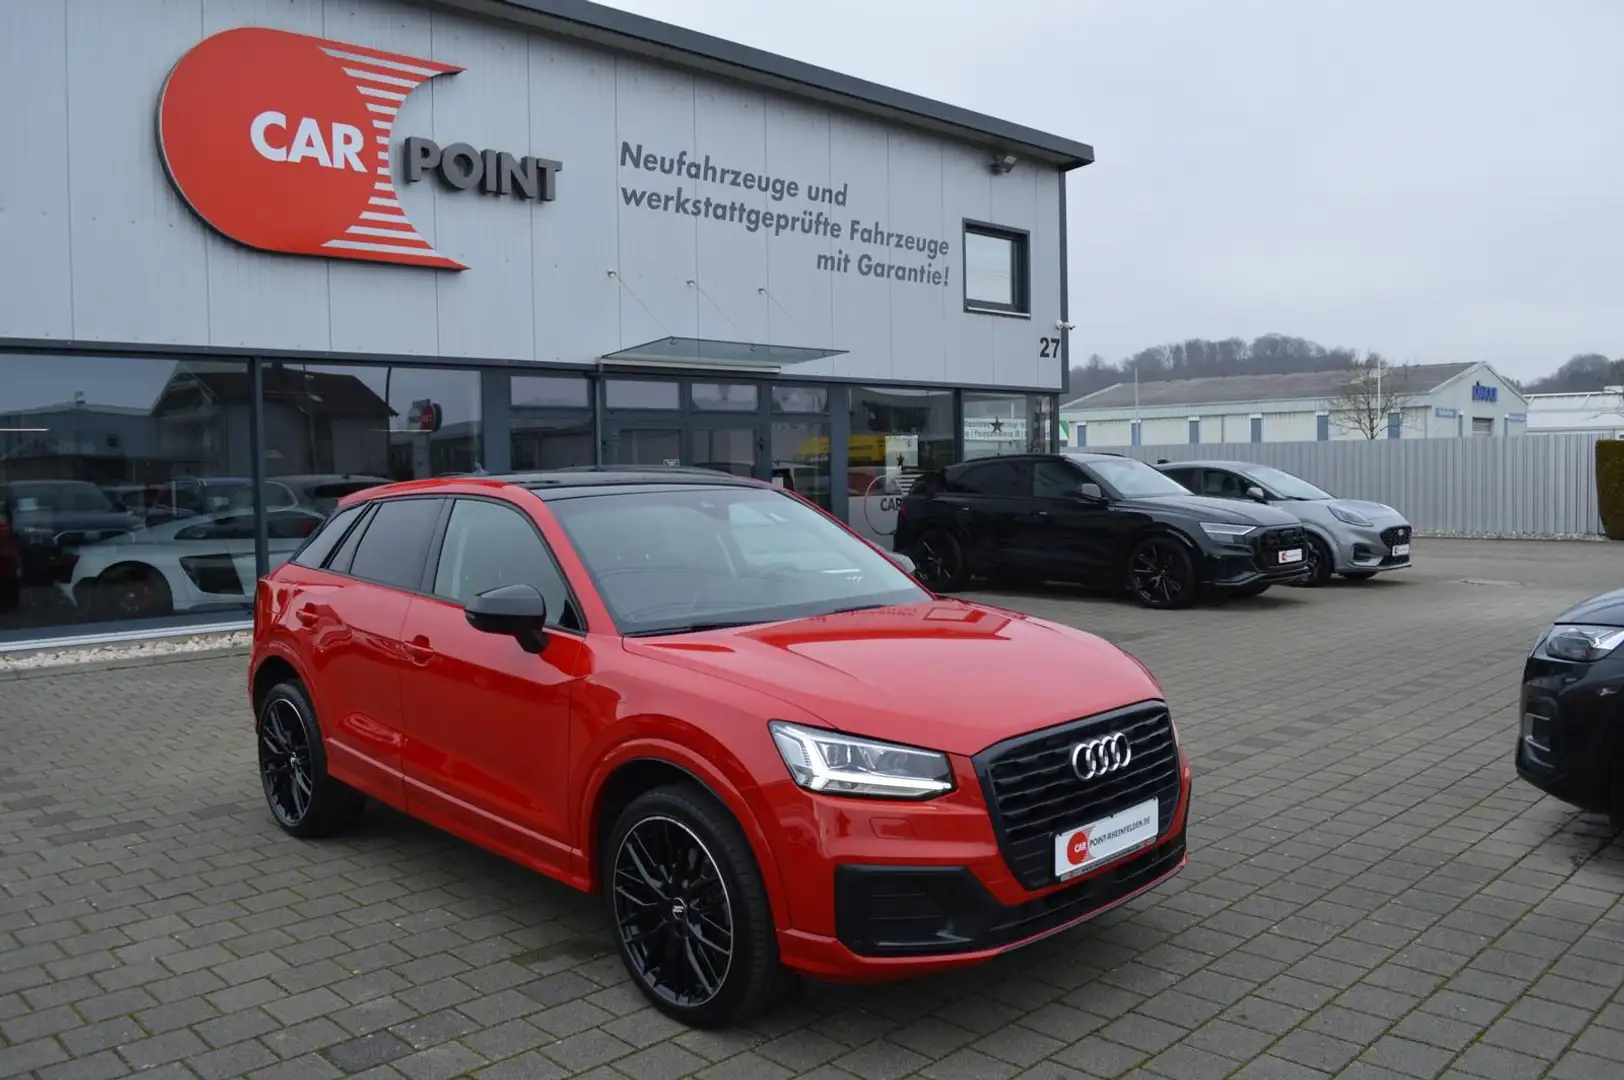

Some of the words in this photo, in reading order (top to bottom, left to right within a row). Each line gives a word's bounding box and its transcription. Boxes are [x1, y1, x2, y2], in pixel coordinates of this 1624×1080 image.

[250, 110, 368, 173] CAR
[404, 136, 563, 202] POINT
[619, 140, 800, 203] Neufahrzeuge
[807, 182, 849, 208] und
[620, 186, 842, 241] werkstattgeprüfte
[849, 219, 950, 261] Fahrzeuge
[816, 249, 851, 274] mit
[857, 255, 950, 287] Garantie!
[1039, 336, 1061, 359] 27
